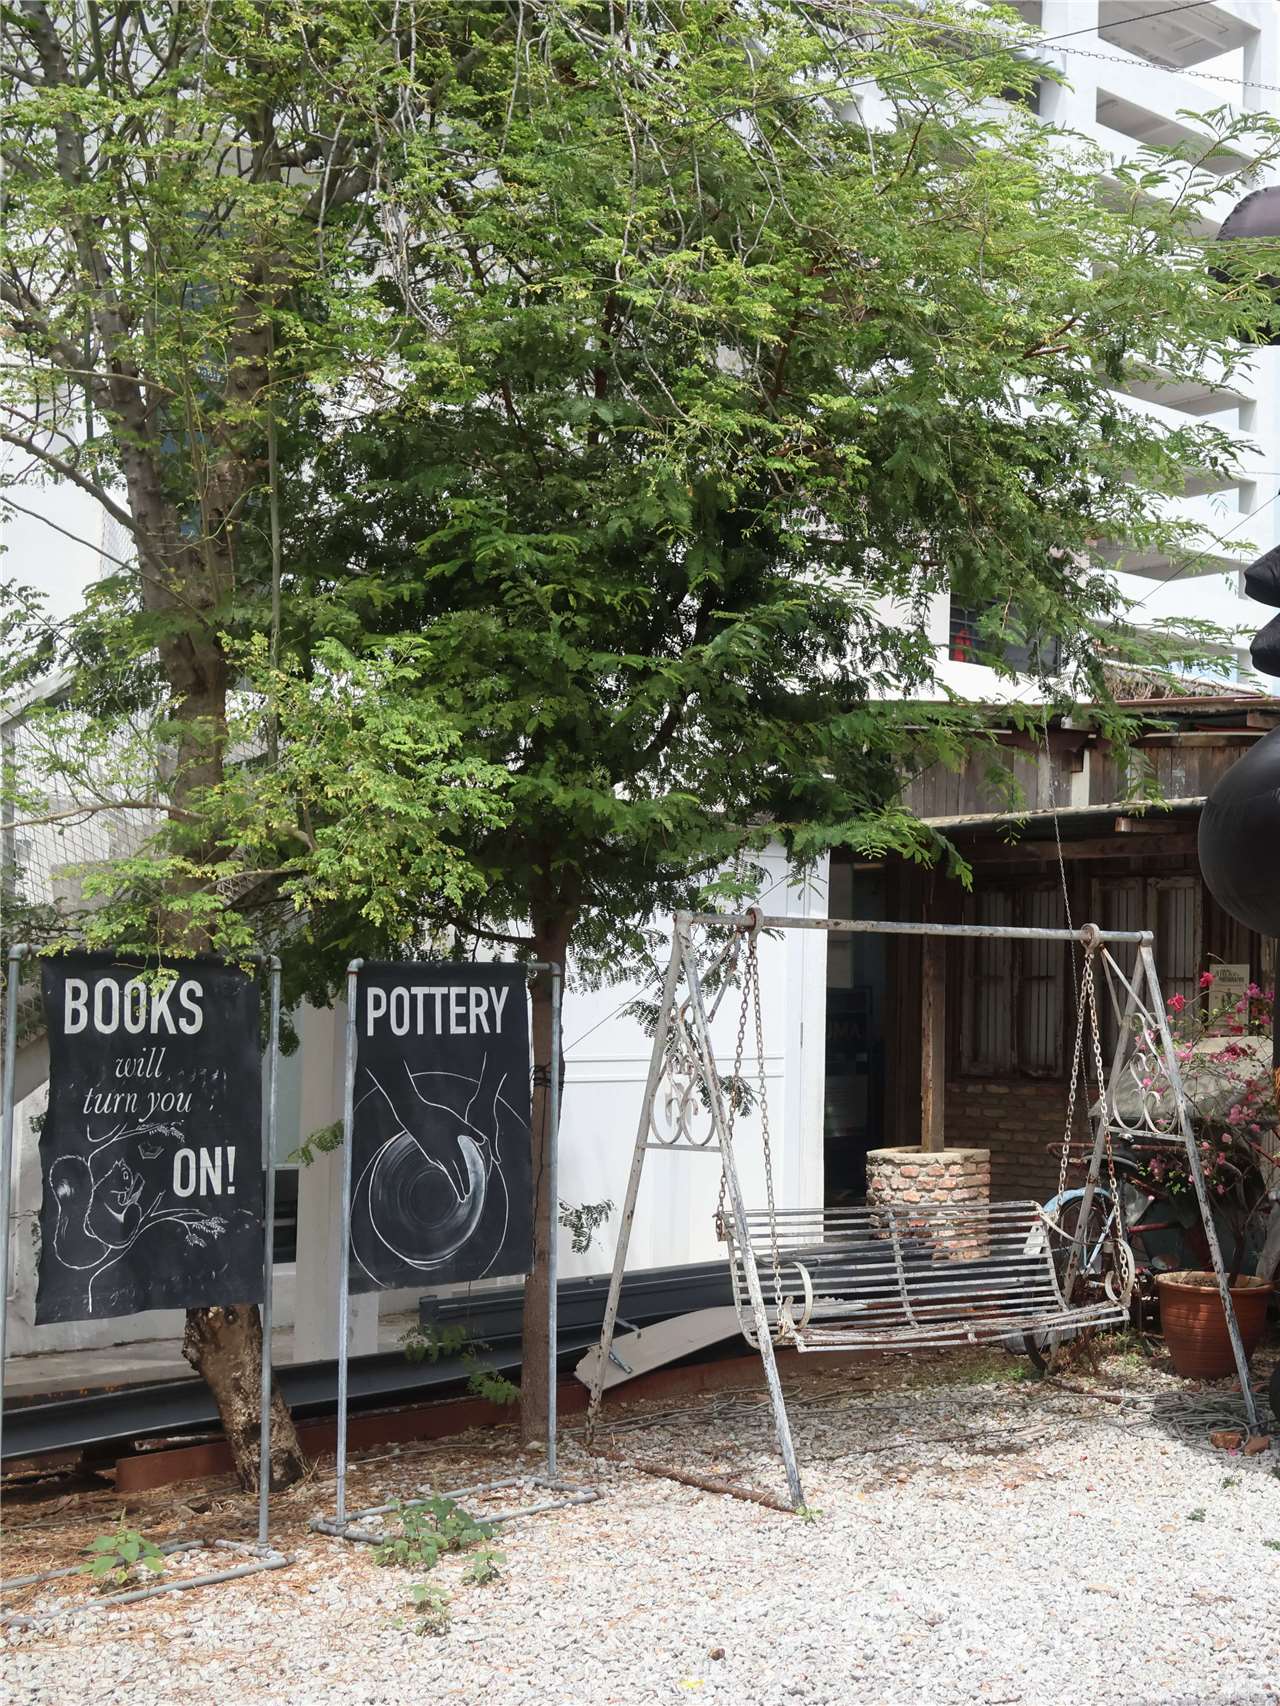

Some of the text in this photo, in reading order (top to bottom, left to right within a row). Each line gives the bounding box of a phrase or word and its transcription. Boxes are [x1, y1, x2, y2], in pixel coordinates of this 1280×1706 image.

[64, 977, 204, 1035] BOOKS
[367, 986, 509, 1036] POTTERY
[115, 1047, 167, 1079] will
[83, 1088, 193, 1122] turn you
[173, 1146, 236, 1197] ON!
